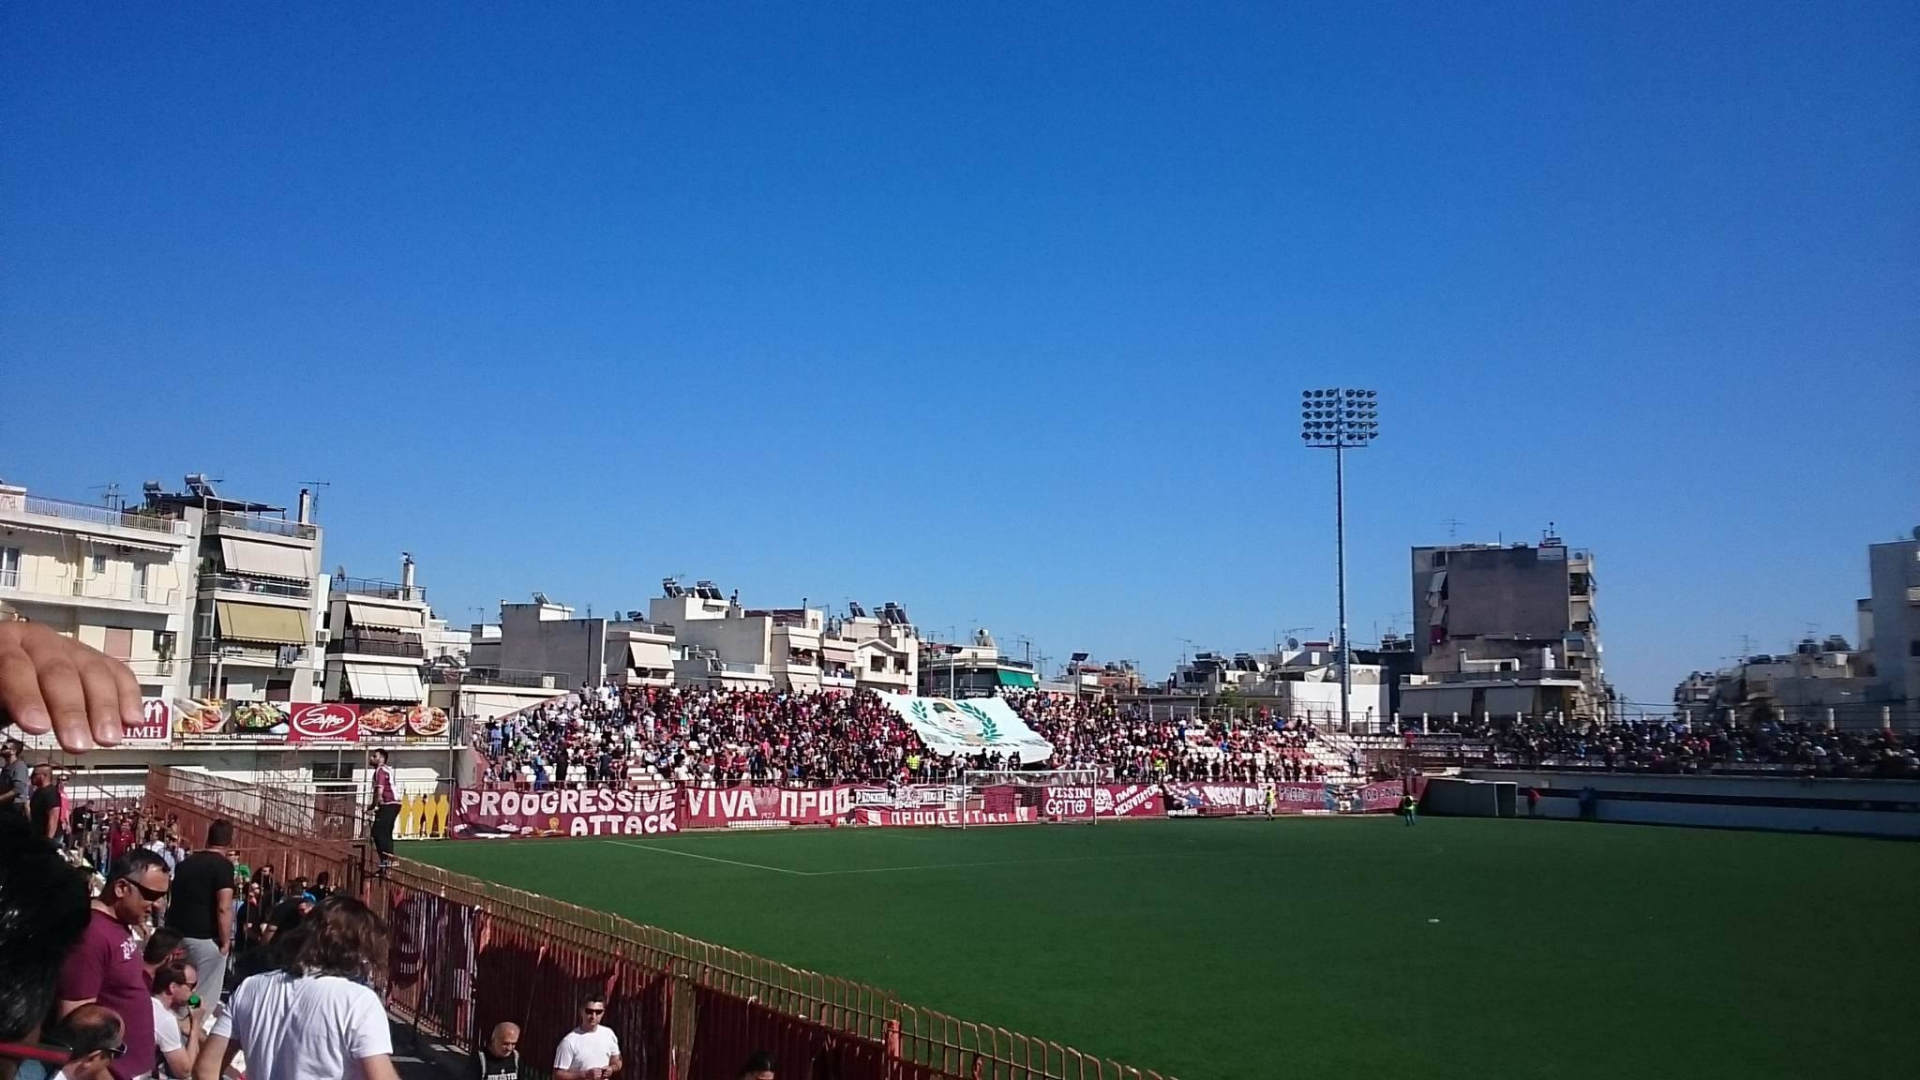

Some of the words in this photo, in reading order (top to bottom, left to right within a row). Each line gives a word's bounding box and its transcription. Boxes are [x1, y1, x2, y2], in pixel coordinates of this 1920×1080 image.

[461, 788, 677, 815] PROOGRESSIVE
[687, 788, 758, 818] VIVA
[1047, 787, 1092, 799] VISSINI
[570, 811, 677, 837] ATTACK
